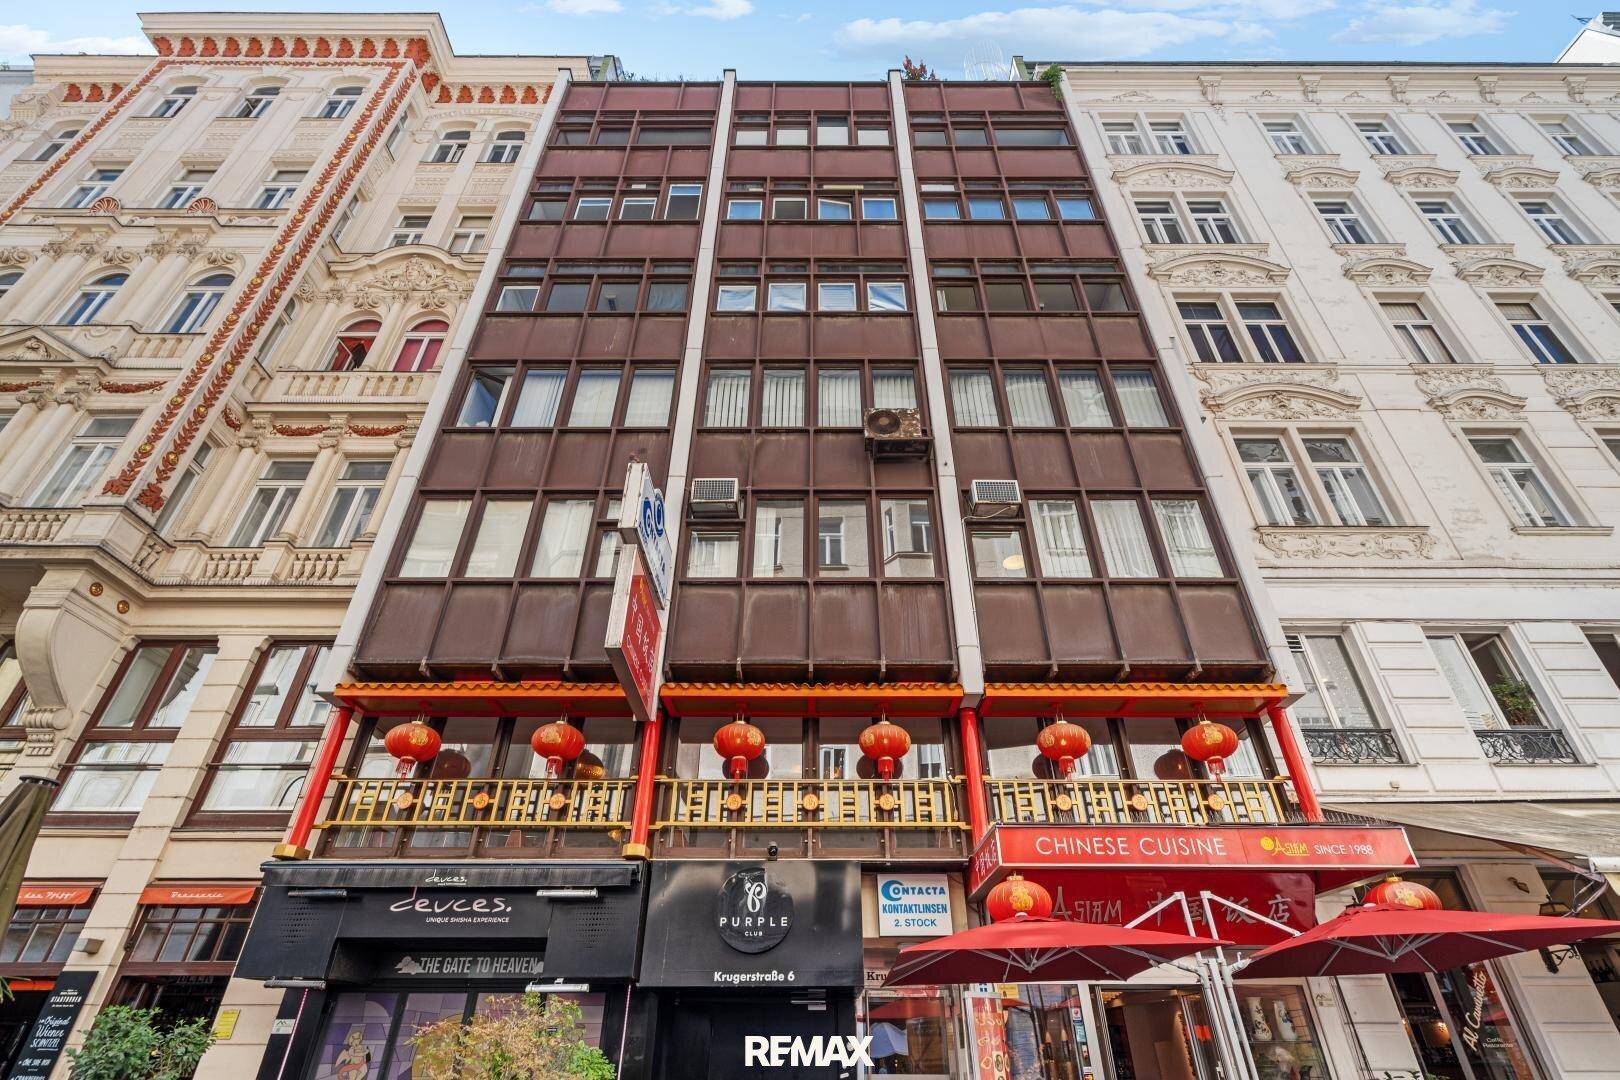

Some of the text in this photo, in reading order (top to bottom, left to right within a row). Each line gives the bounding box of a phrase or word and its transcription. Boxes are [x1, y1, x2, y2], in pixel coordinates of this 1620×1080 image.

[1036, 837, 1227, 855] CHINESE CUISINE
[1314, 844, 1348, 855] SINCE
[1349, 844, 1374, 855] 1988
[881, 880, 946, 901] CONTACTA
[882, 903, 948, 914] KONTAKTLINSEN
[719, 916, 788, 927] PURPLE
[894, 918, 937, 928] 2. STOCK
[420, 957, 538, 975] THE GATE TO HEAVEN
[714, 970, 796, 984] Krugerstraße 6
[44, 1016, 71, 1027] Original
[36, 1025, 64, 1037] Wiener
[1463, 1026, 1479, 1051] Al
